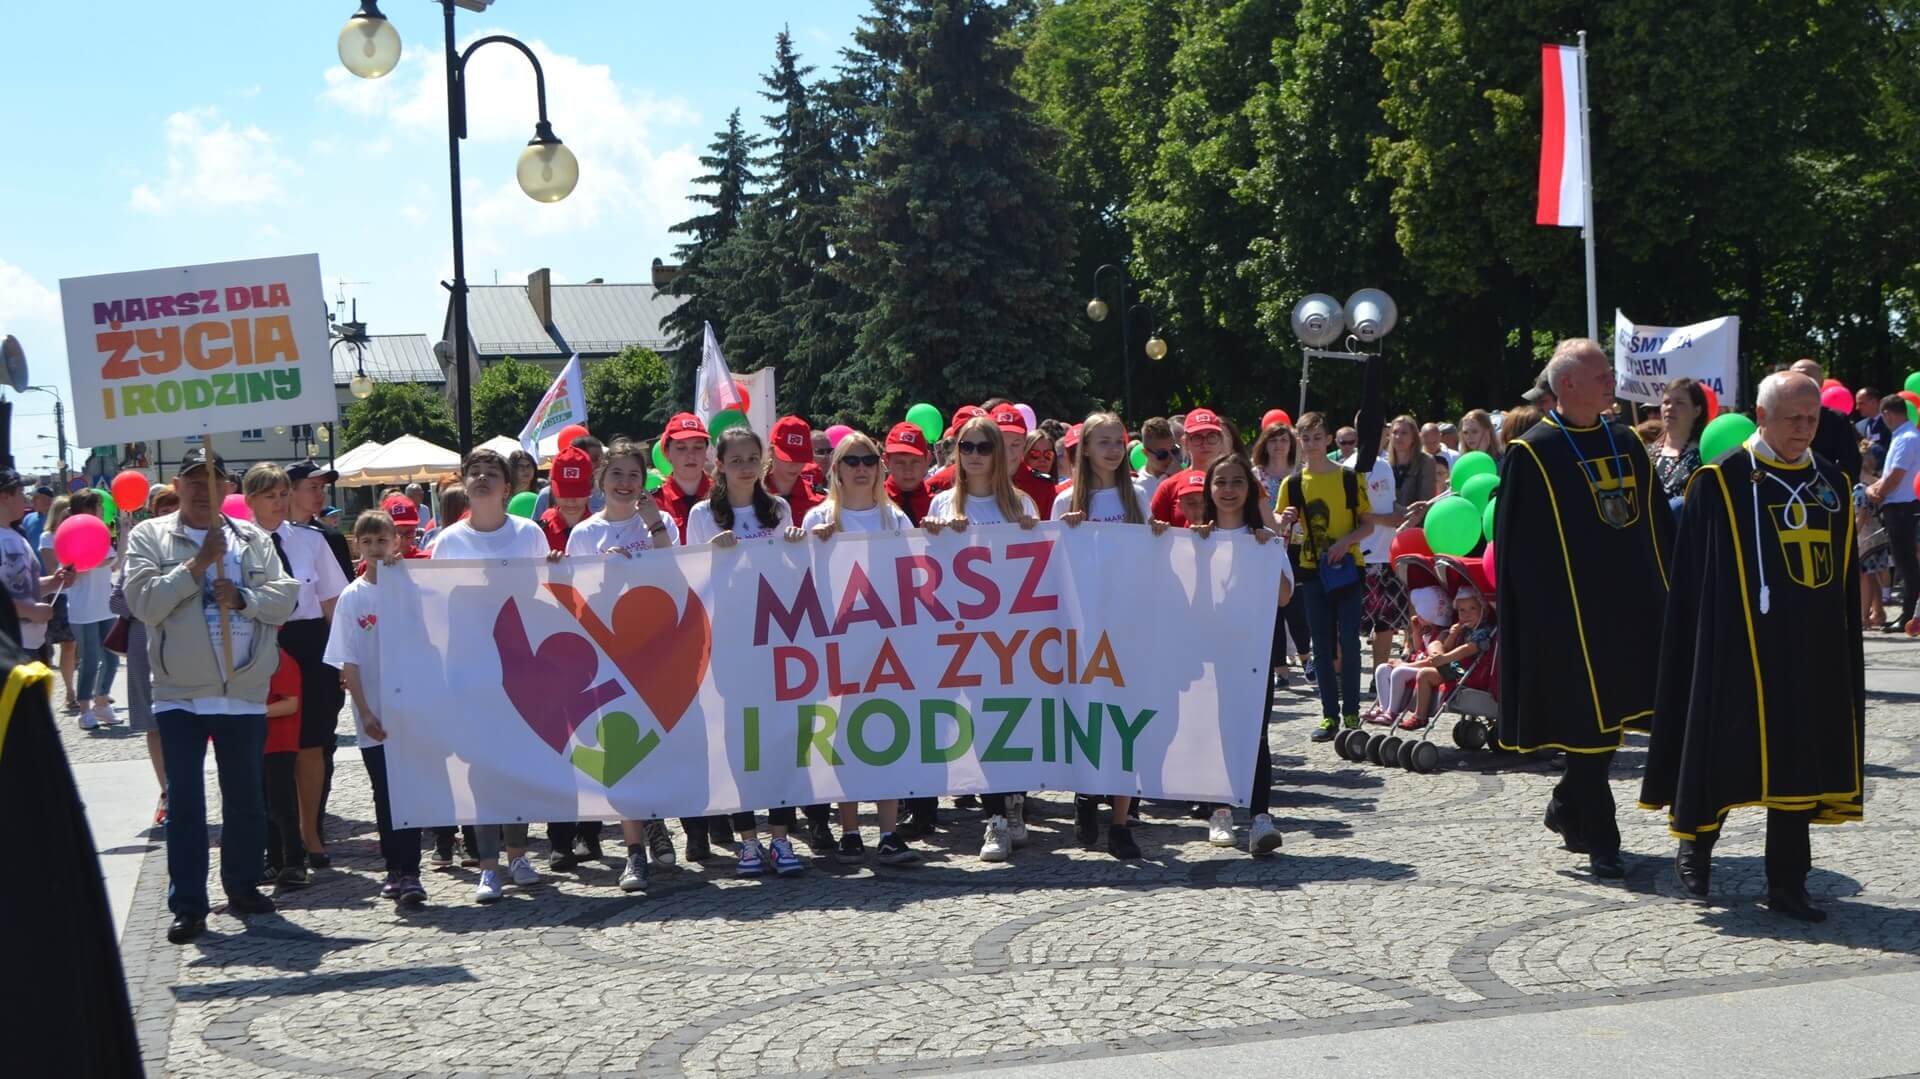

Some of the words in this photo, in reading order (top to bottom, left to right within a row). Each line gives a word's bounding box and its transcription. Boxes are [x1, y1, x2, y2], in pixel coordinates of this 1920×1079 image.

[93, 289, 220, 325] MARSZ
[225, 283, 290, 311] DLA
[96, 315, 299, 379] ŻYCIA
[102, 387, 116, 419] I
[121, 367, 302, 417] RODZINY
[753, 540, 1059, 646] MARSZ
[773, 637, 915, 701] DLA
[936, 620, 1125, 689] ŻYCIA
[743, 706, 760, 772] I
[796, 696, 1158, 772] RODZINY
